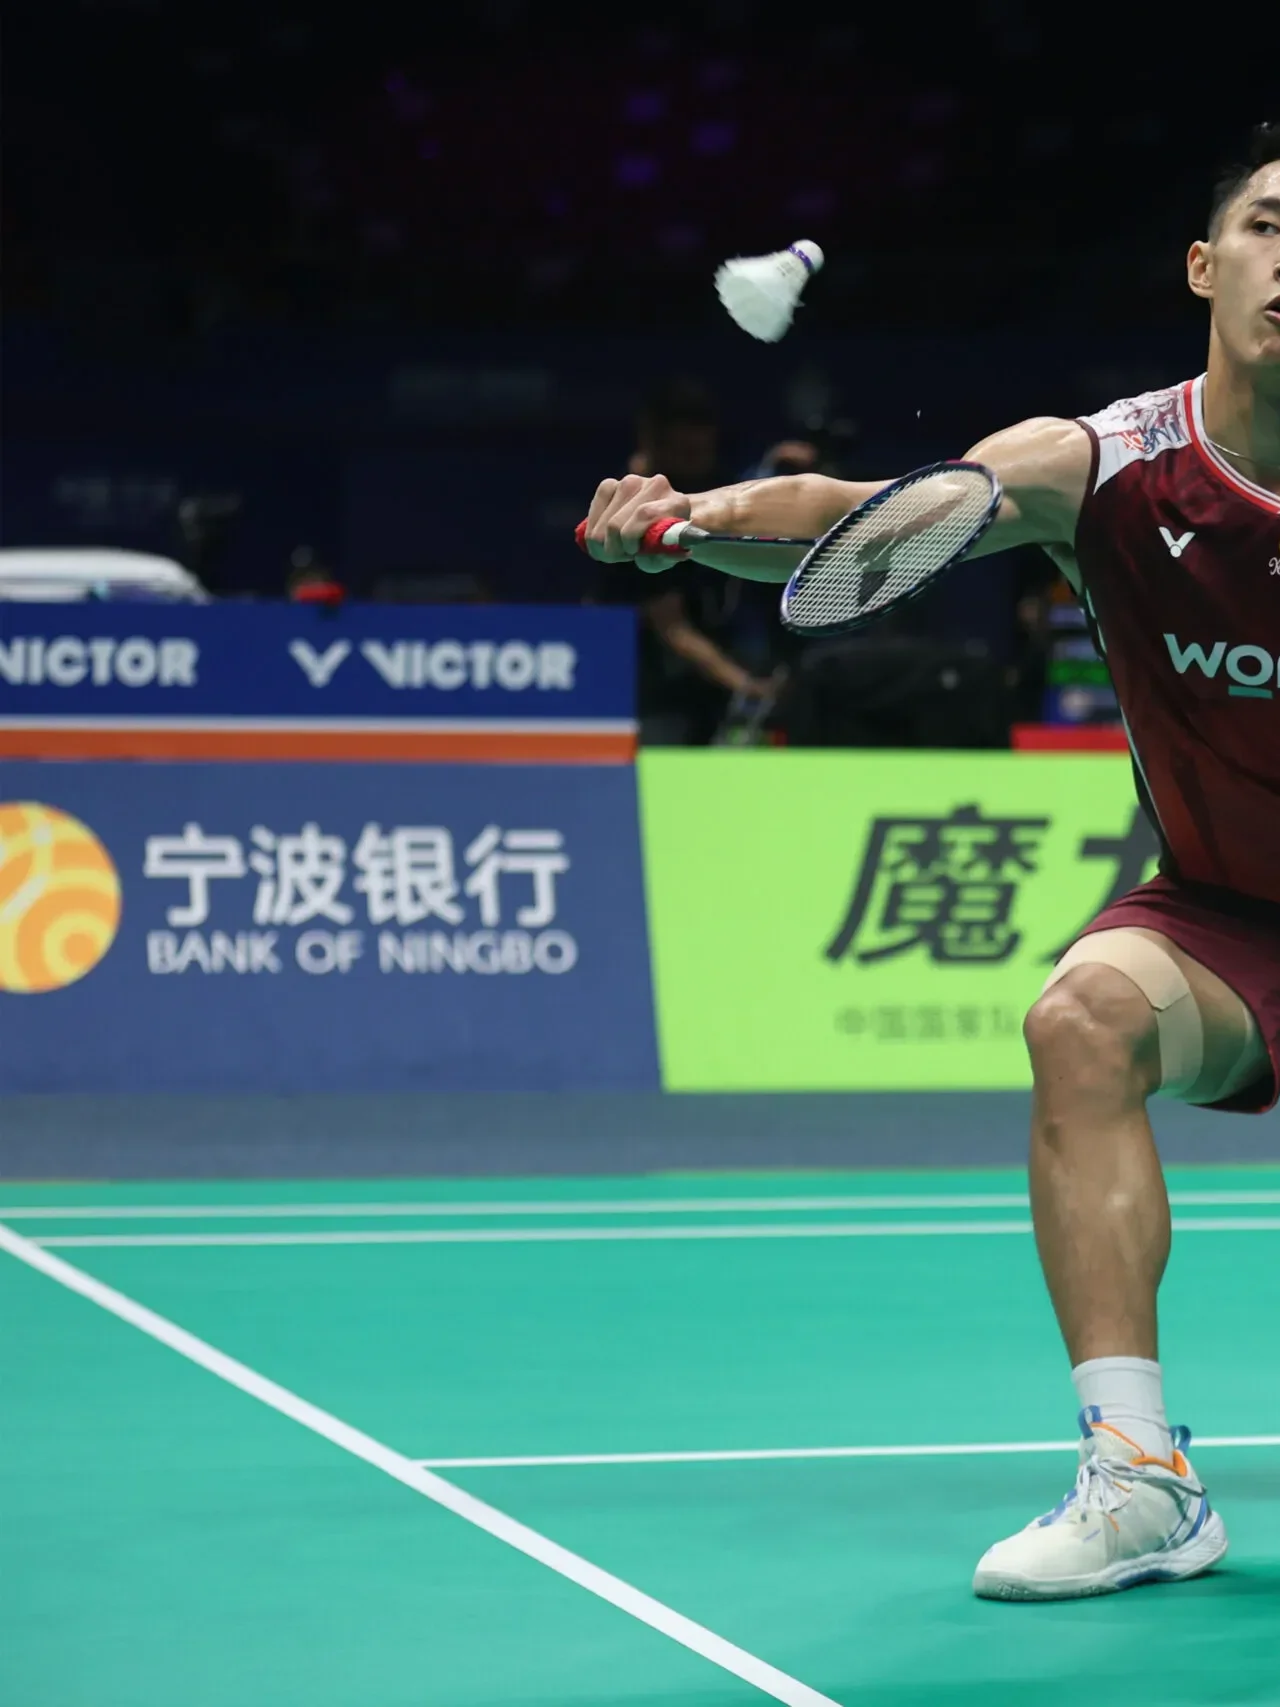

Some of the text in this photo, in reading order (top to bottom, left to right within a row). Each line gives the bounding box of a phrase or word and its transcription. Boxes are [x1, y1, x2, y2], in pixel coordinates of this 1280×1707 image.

[362, 641, 577, 690] VICTOR
[144, 823, 570, 927] 宁波银行
[147, 930, 578, 974] BANK OF NINGBO
